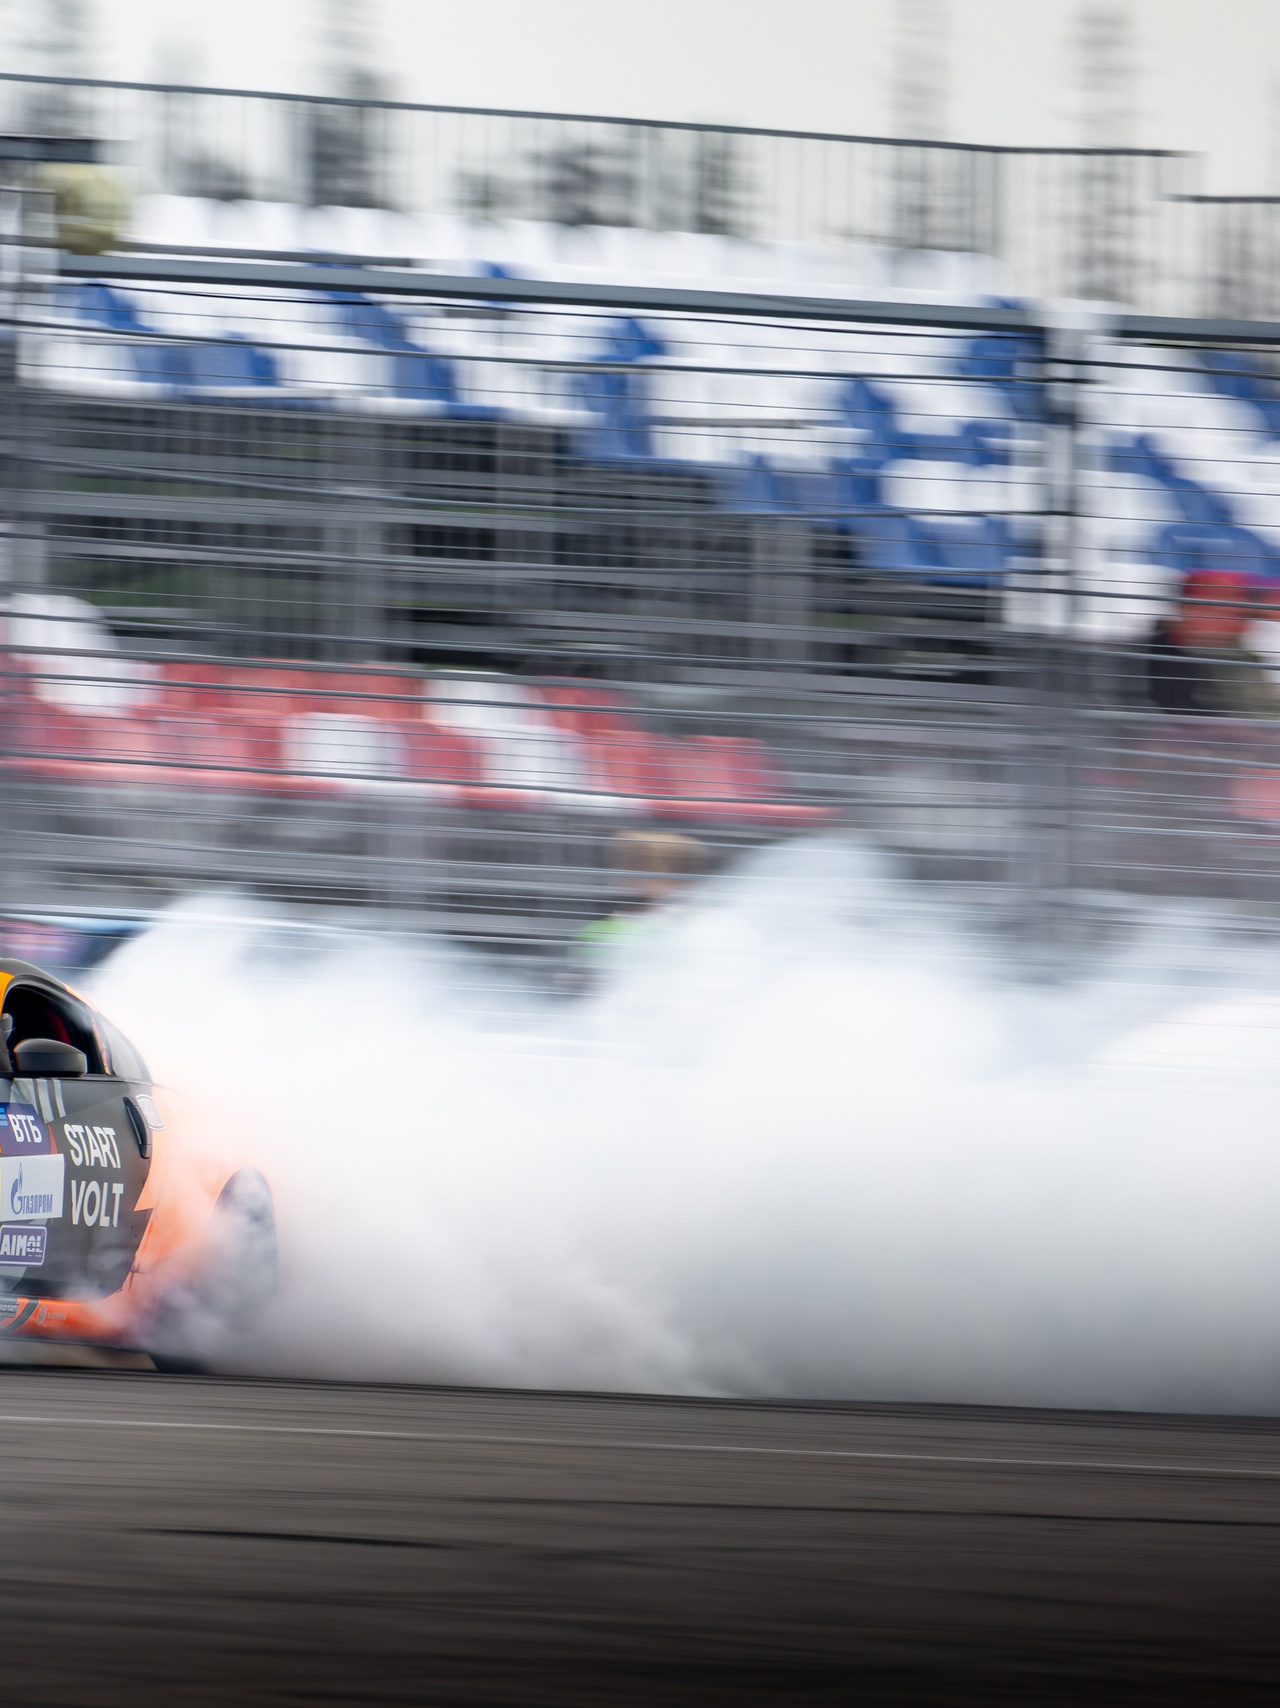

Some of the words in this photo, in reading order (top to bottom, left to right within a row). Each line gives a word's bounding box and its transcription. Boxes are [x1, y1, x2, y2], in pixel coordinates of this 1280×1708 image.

[7, 1114, 42, 1143] ВТБ
[63, 1123, 121, 1169] START
[22, 1194, 53, 1215] ГАЗПРОМ
[70, 1180, 124, 1228] VOLT
[0, 1234, 43, 1258] AIMOL
